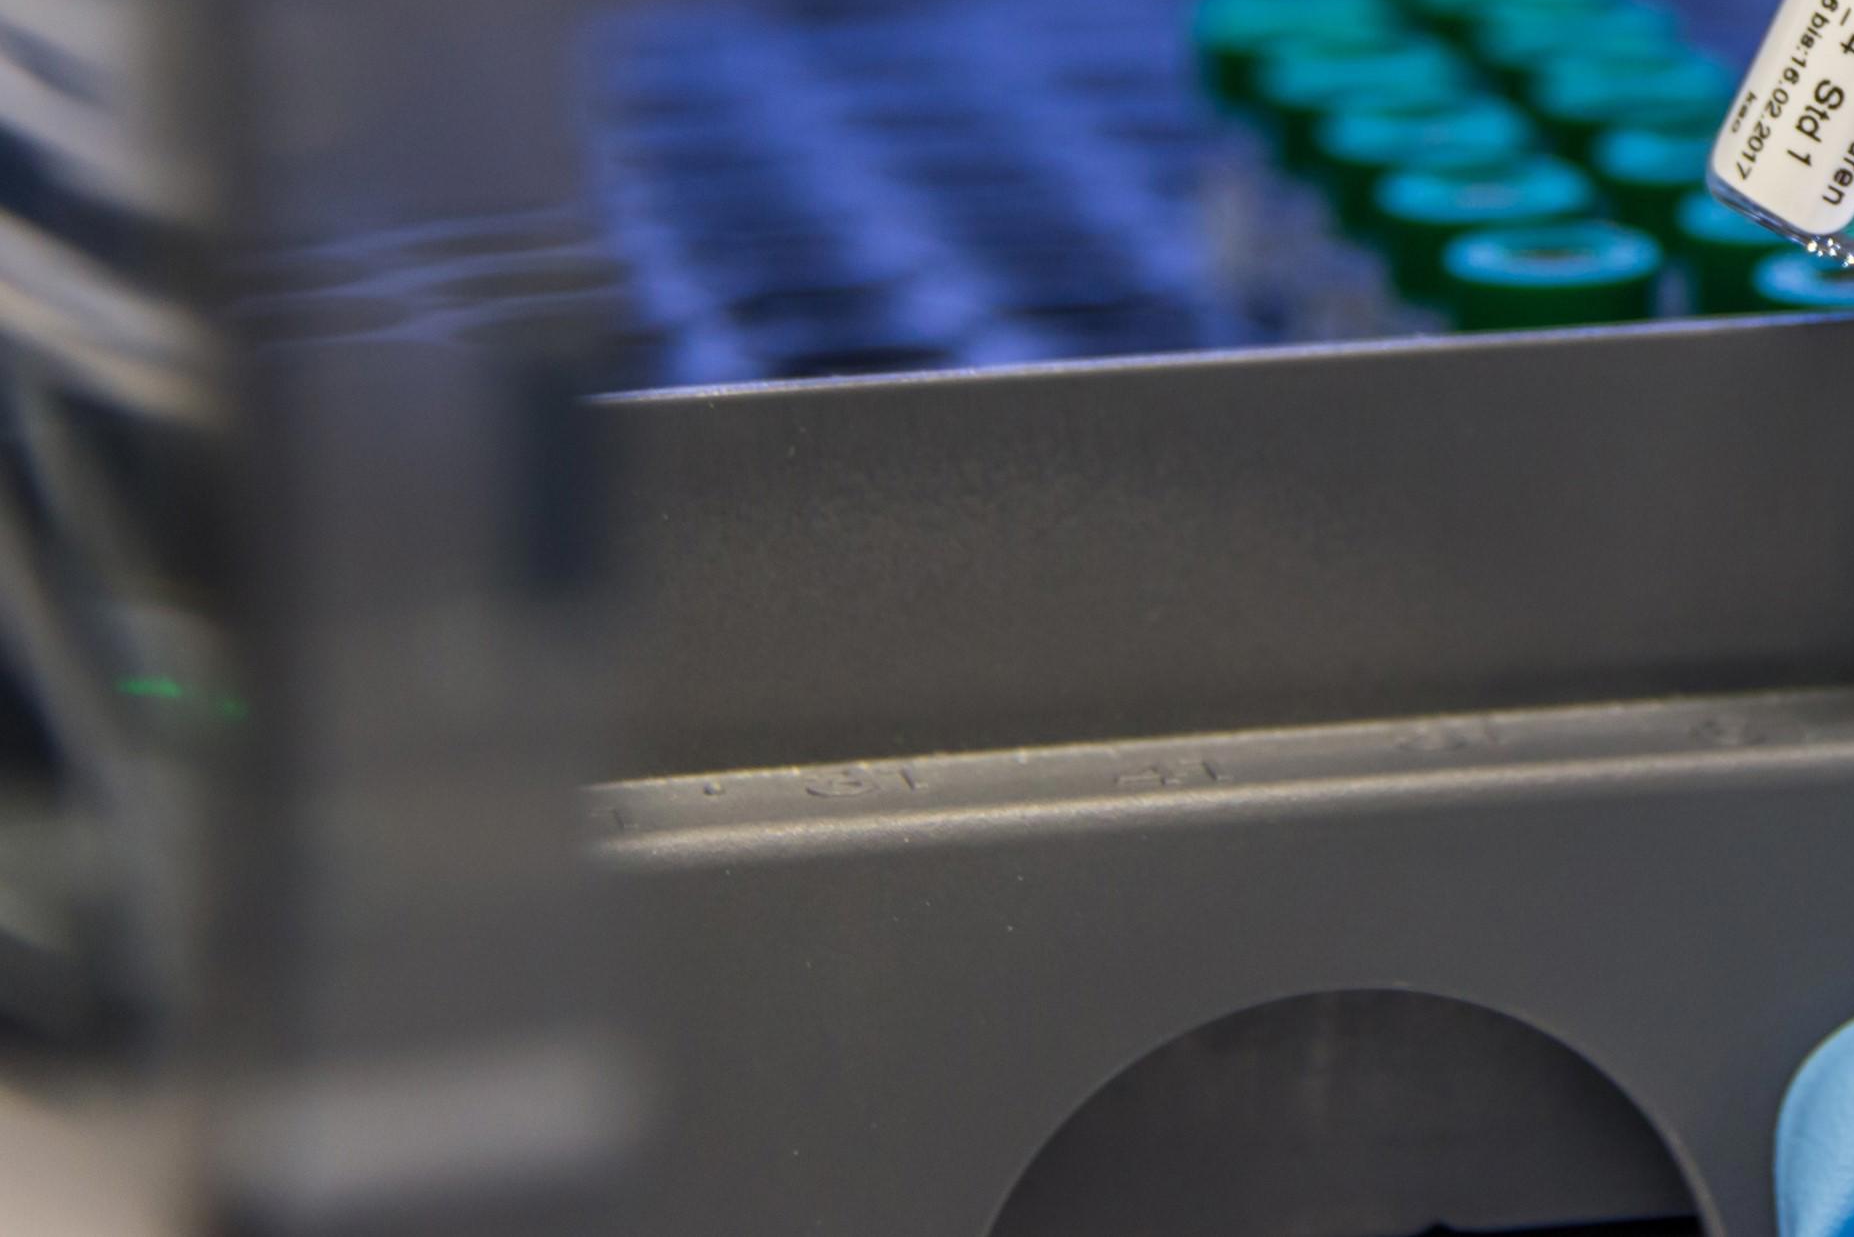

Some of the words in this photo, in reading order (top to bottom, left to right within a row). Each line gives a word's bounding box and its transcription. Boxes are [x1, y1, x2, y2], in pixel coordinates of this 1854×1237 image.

[1736, 12, 1830, 181] bis:16.02.2017
[1795, 79, 1845, 143] Std
[1787, 149, 1812, 167] 1
